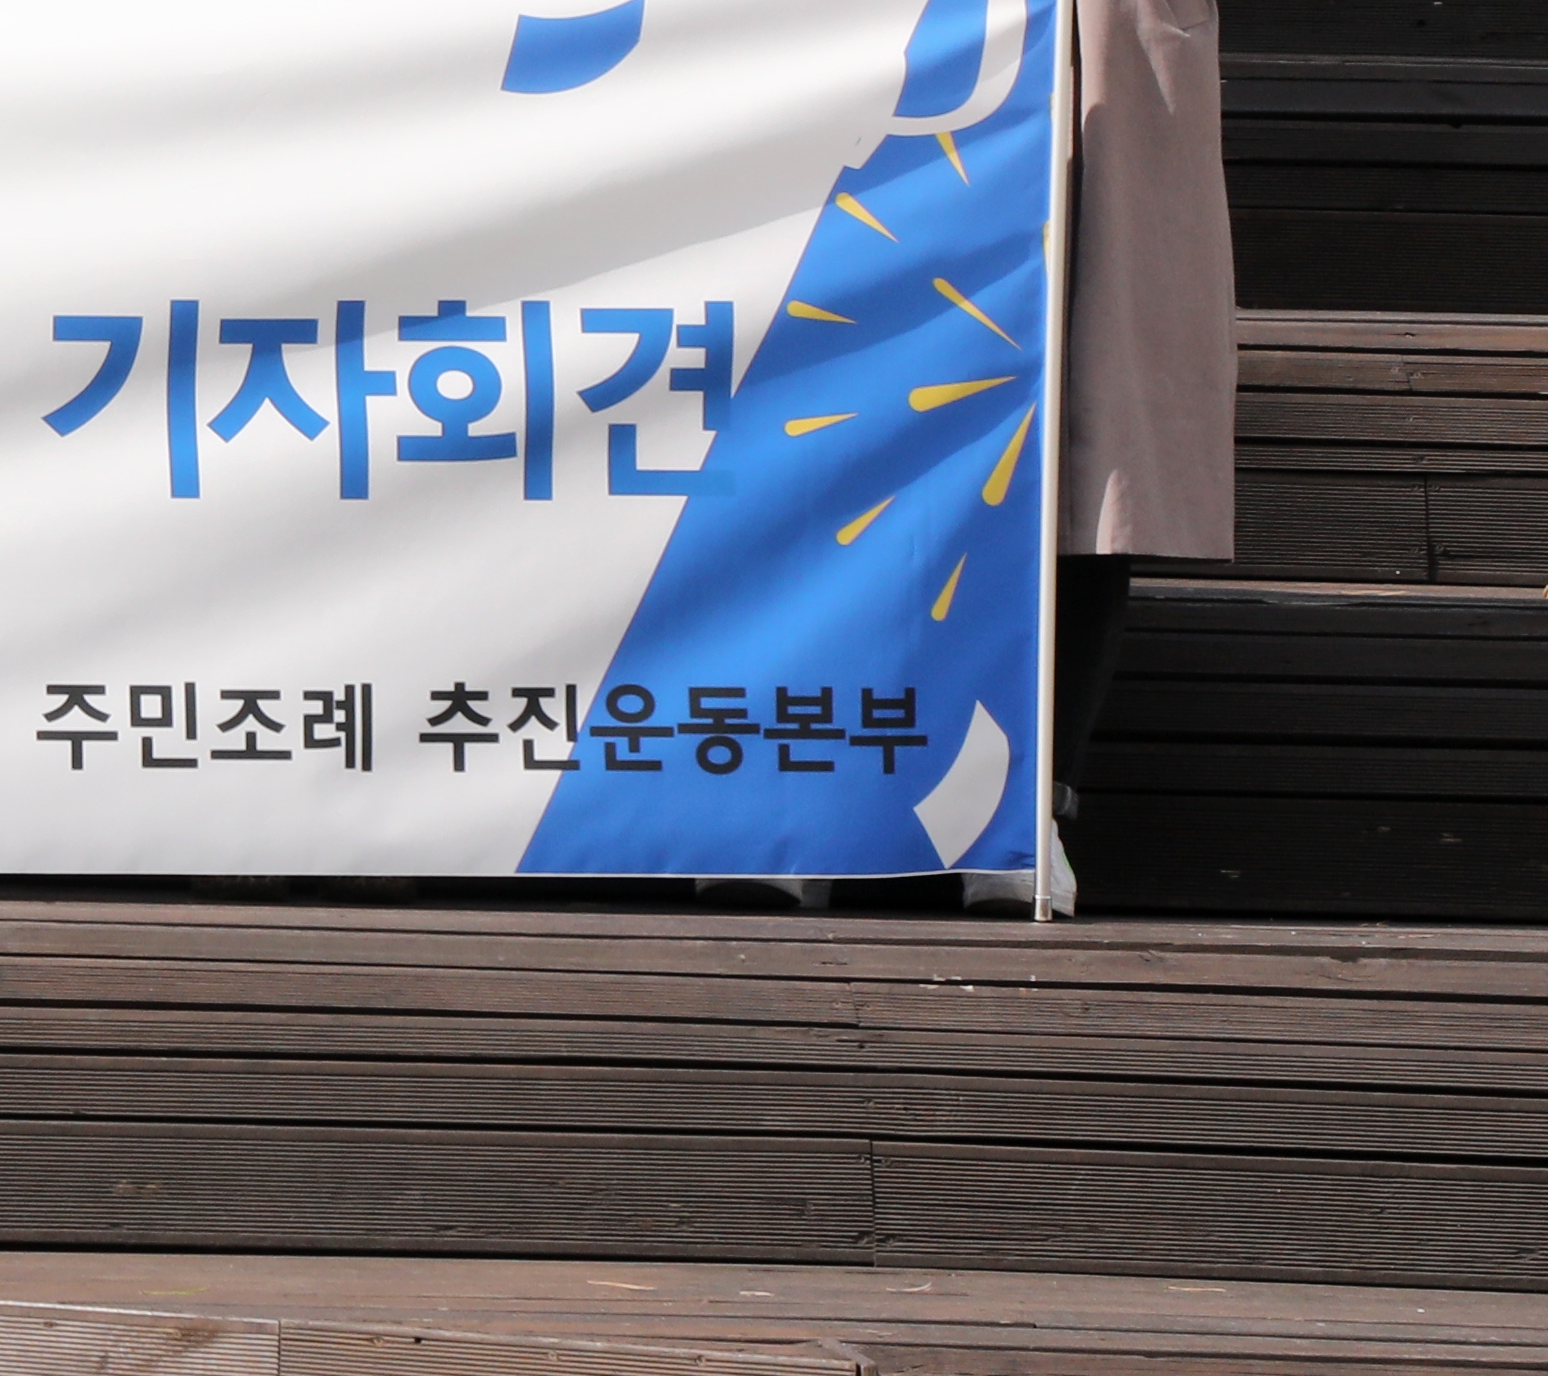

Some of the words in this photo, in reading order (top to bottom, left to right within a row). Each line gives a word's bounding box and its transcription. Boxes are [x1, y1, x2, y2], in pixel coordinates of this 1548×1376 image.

[42, 300, 735, 501] 기자회견
[37, 683, 372, 771] 주민조례
[419, 682, 928, 775] 추진운동본부
